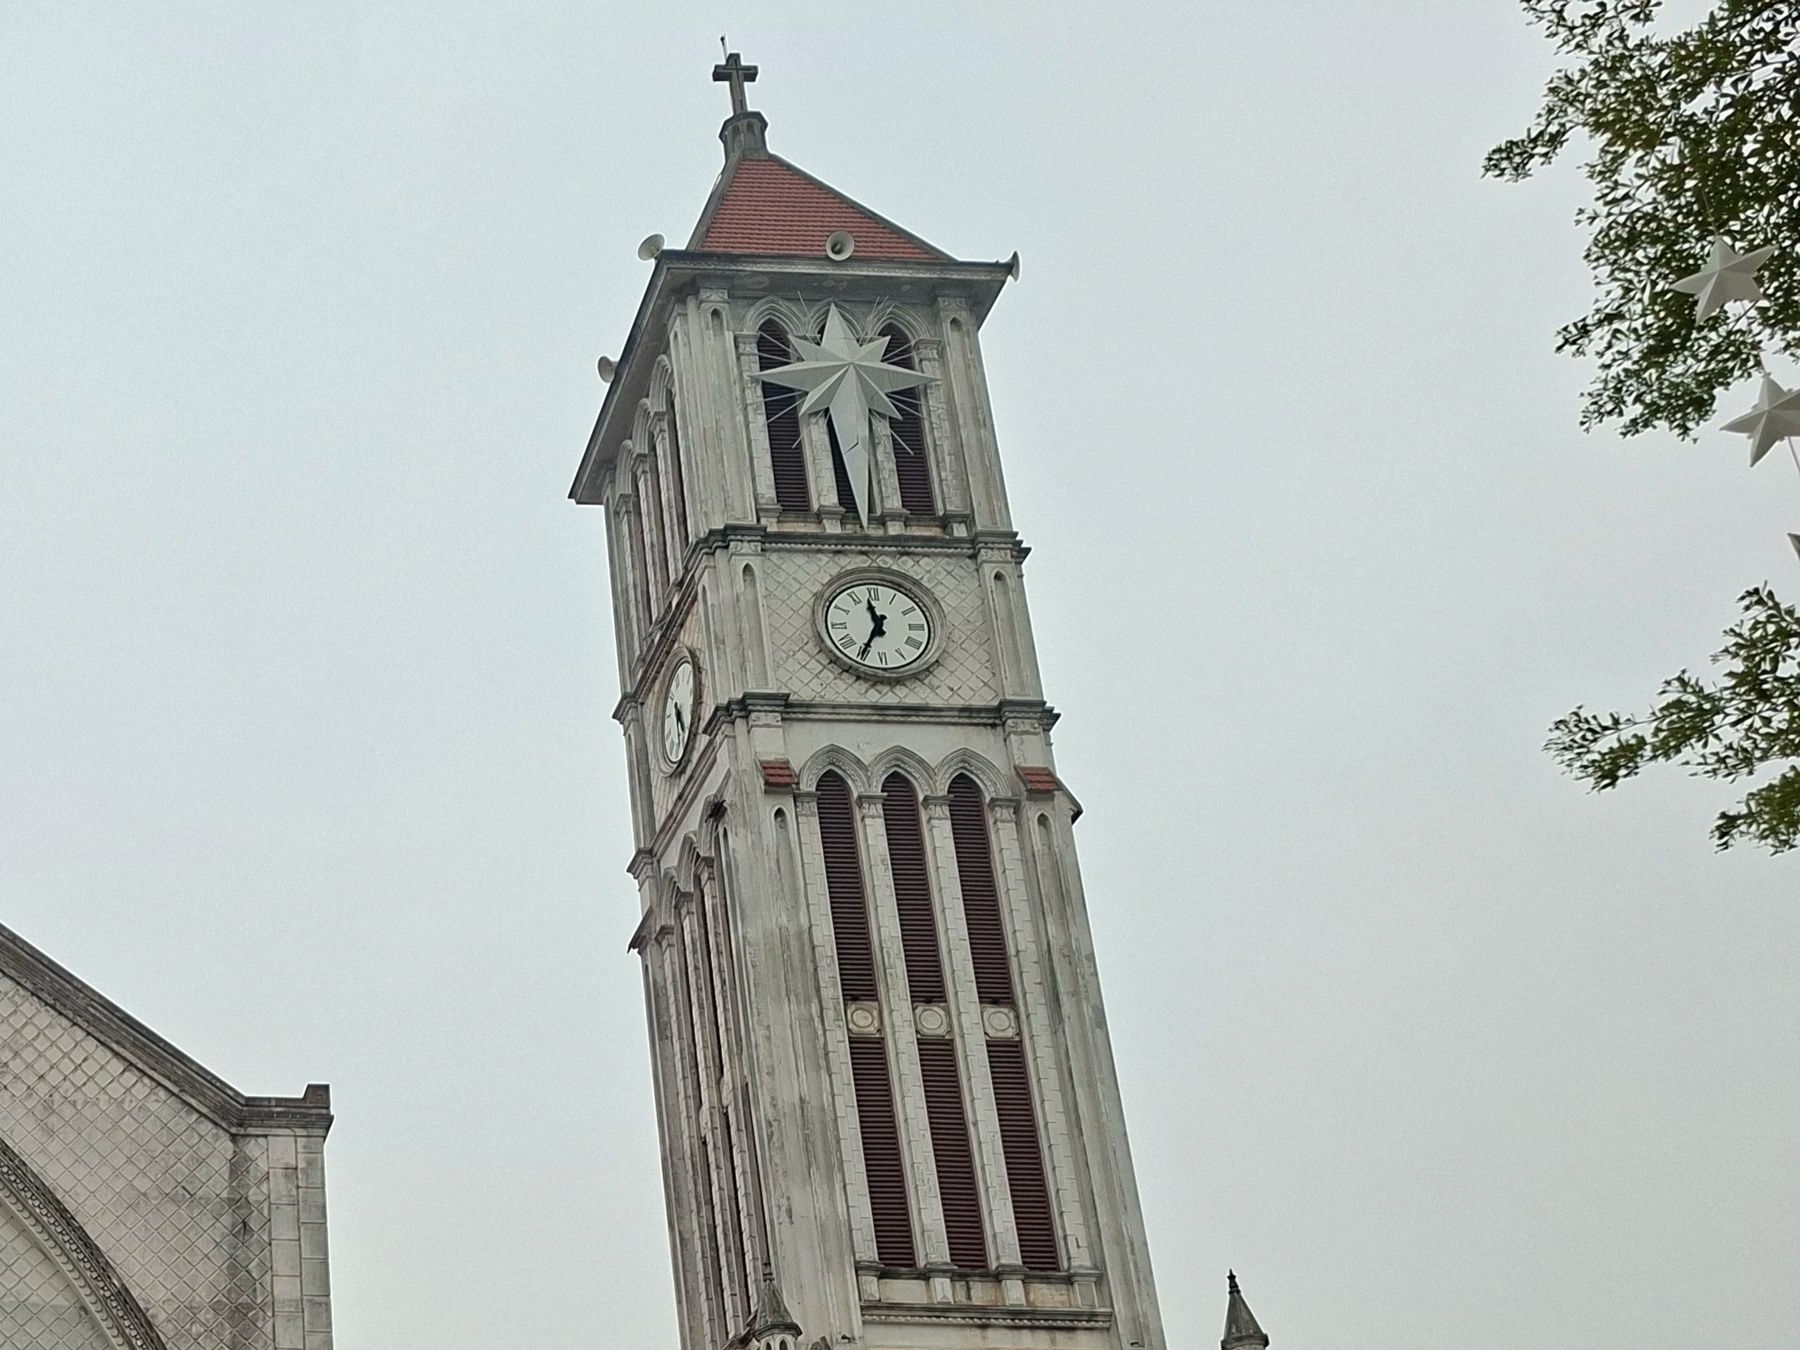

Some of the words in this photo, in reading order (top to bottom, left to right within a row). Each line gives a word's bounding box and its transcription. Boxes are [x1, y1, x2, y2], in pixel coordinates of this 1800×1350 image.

[846, 590, 863, 606] XI
[866, 587, 880, 602] XII
[833, 604, 850, 616] X
[901, 606, 916, 616] II
[907, 623, 925, 631] III
[838, 633, 857, 650] VIII
[856, 645, 870, 661] VI
